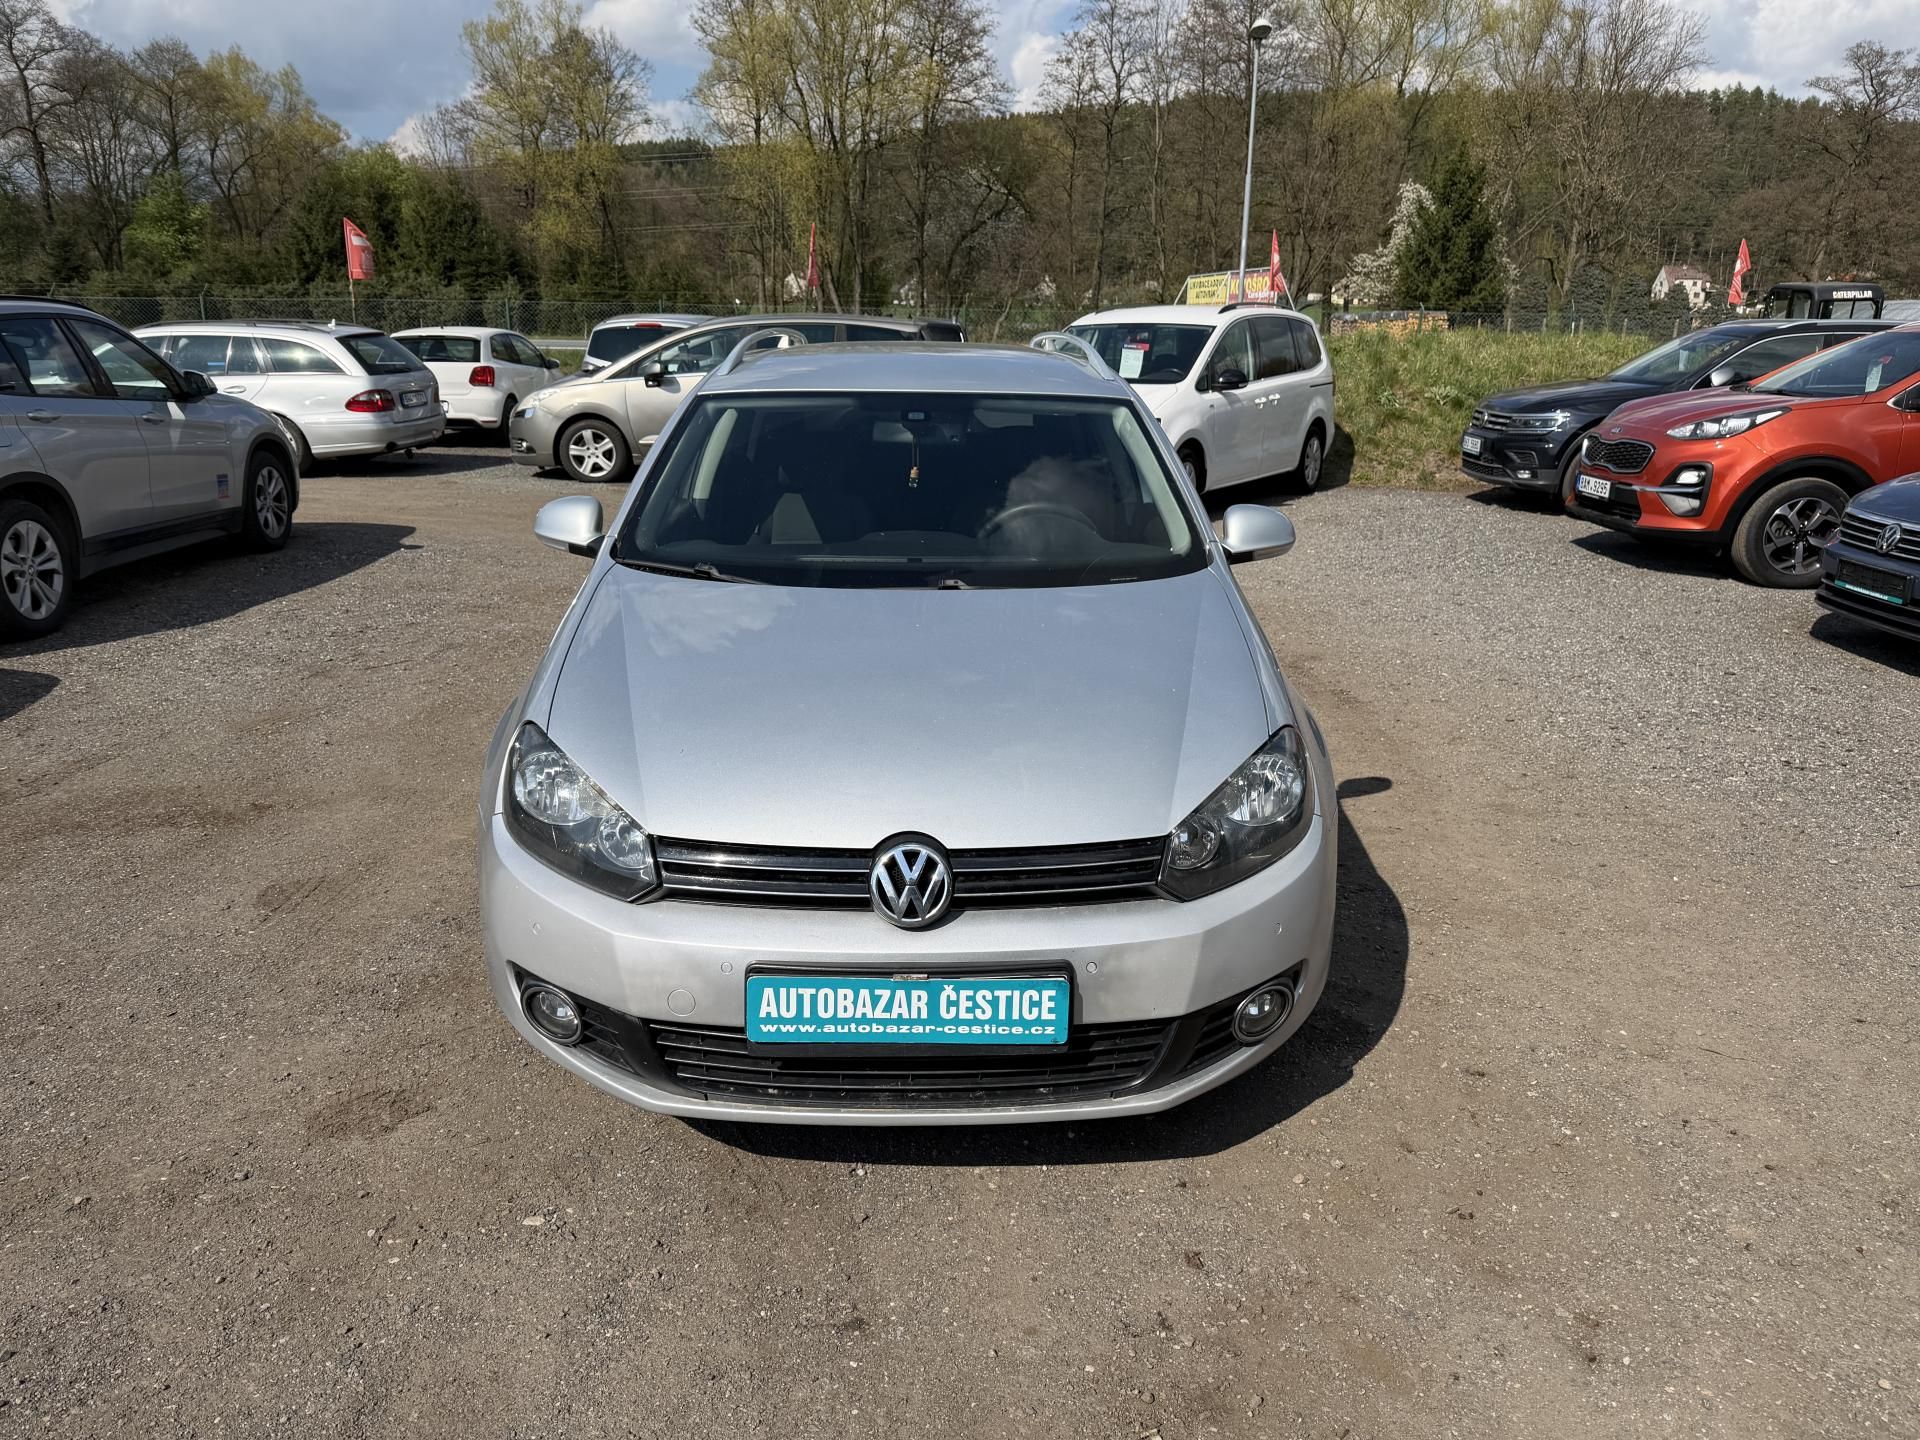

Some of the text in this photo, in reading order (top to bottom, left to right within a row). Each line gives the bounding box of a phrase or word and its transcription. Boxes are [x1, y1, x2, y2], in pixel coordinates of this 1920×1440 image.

[1832, 290, 1873, 299] CATERPILLAR
[758, 984, 1057, 1020] AUTOBAZAR ČESTICE
[759, 1022, 1056, 1035] www.autobazar-cestice.cz
